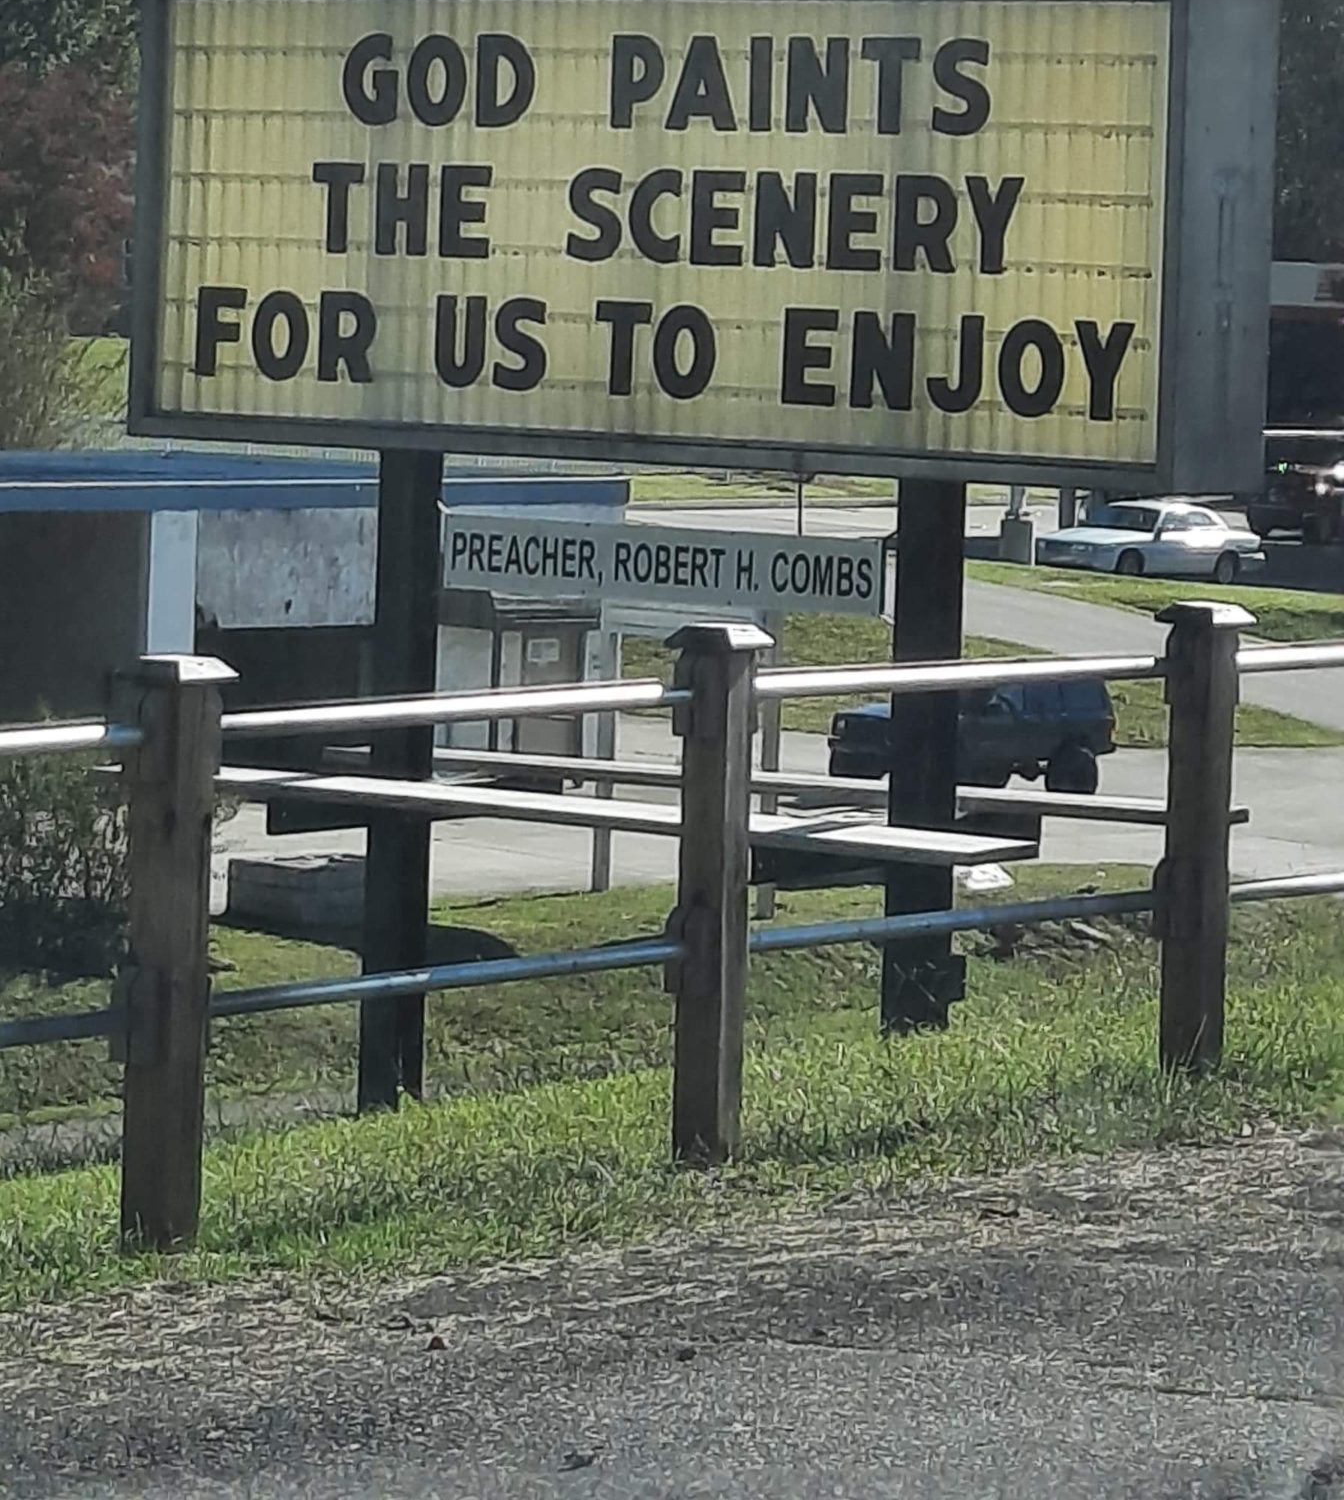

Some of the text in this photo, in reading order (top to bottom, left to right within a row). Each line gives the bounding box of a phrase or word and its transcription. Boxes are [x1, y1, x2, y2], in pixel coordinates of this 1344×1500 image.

[343, 34, 991, 137] GOD PAINTS
[312, 162, 1024, 274] THE SCENERY
[196, 287, 1135, 420] FOR US TO ENJOY
[451, 531, 873, 599] PREACHER, ROBERT H. COMBS
